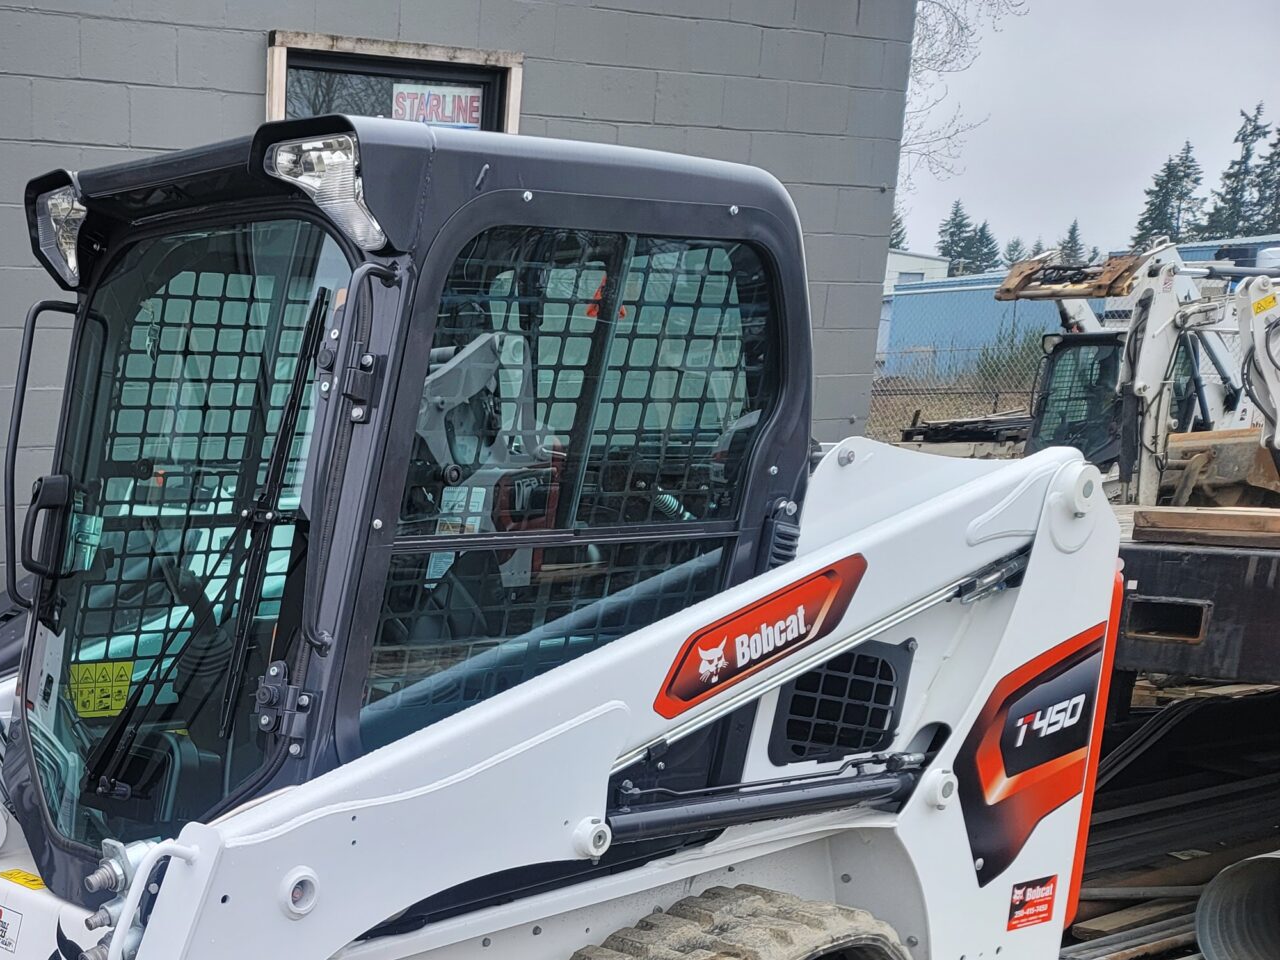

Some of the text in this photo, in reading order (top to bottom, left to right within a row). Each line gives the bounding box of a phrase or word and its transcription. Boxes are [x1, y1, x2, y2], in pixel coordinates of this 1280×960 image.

[394, 91, 481, 123] STARLINE
[735, 604, 807, 668] Bobcat
[1016, 693, 1087, 748] T450
[1025, 882, 1054, 901] Bobcat
